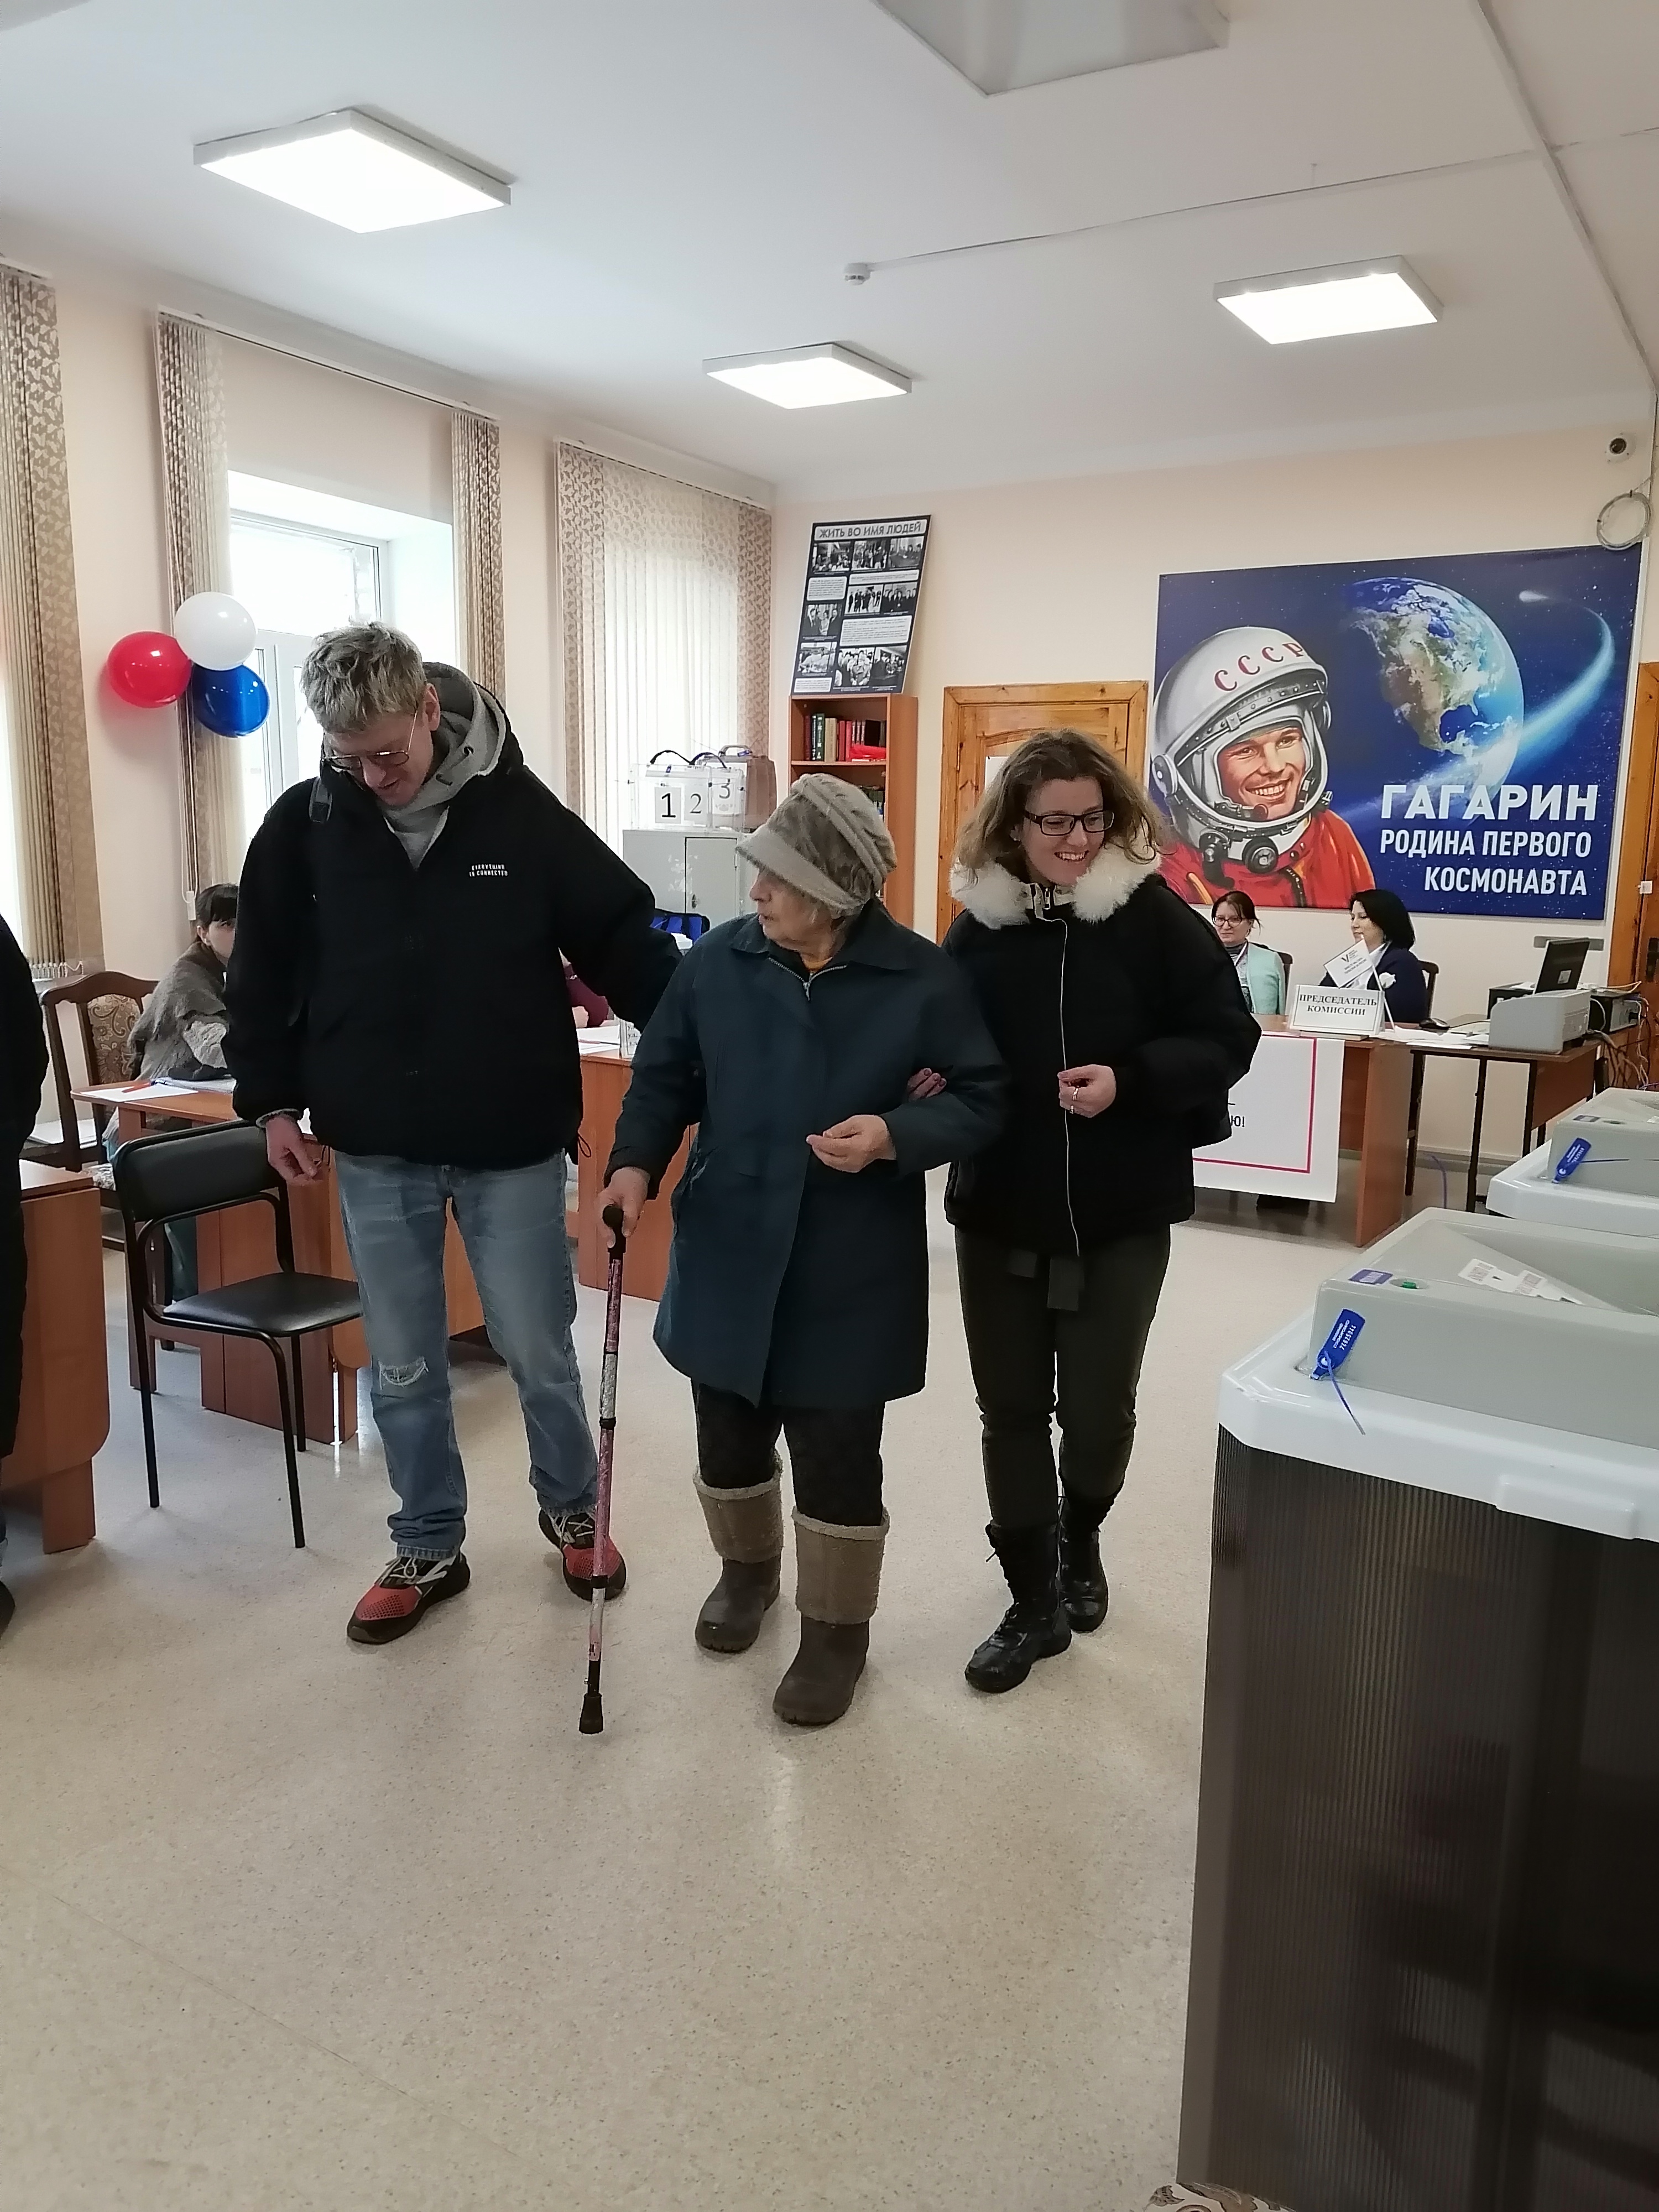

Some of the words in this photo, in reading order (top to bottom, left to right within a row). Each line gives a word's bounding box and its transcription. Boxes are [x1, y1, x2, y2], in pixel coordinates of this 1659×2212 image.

[820, 528, 844, 538] ЖИТЬ
[848, 528, 861, 536] ВО
[864, 526, 884, 535] ИМЯ
[886, 521, 921, 534] ЛЮДЕЙ
[1214, 642, 1303, 691] СССР
[661, 793, 676, 818] 1
[690, 793, 702, 813] 2
[1381, 785, 1598, 821] ГАГАРИН
[1380, 830, 1475, 858] РОДИНА
[1482, 831, 1592, 857] ПЕРВОГО
[1425, 867, 1587, 895] КОСМОНАВТА
[1300, 994, 1377, 1006] ПРЕДСЕДАТЕЛЬ
[1307, 1005, 1365, 1015] КОМИССИИ
